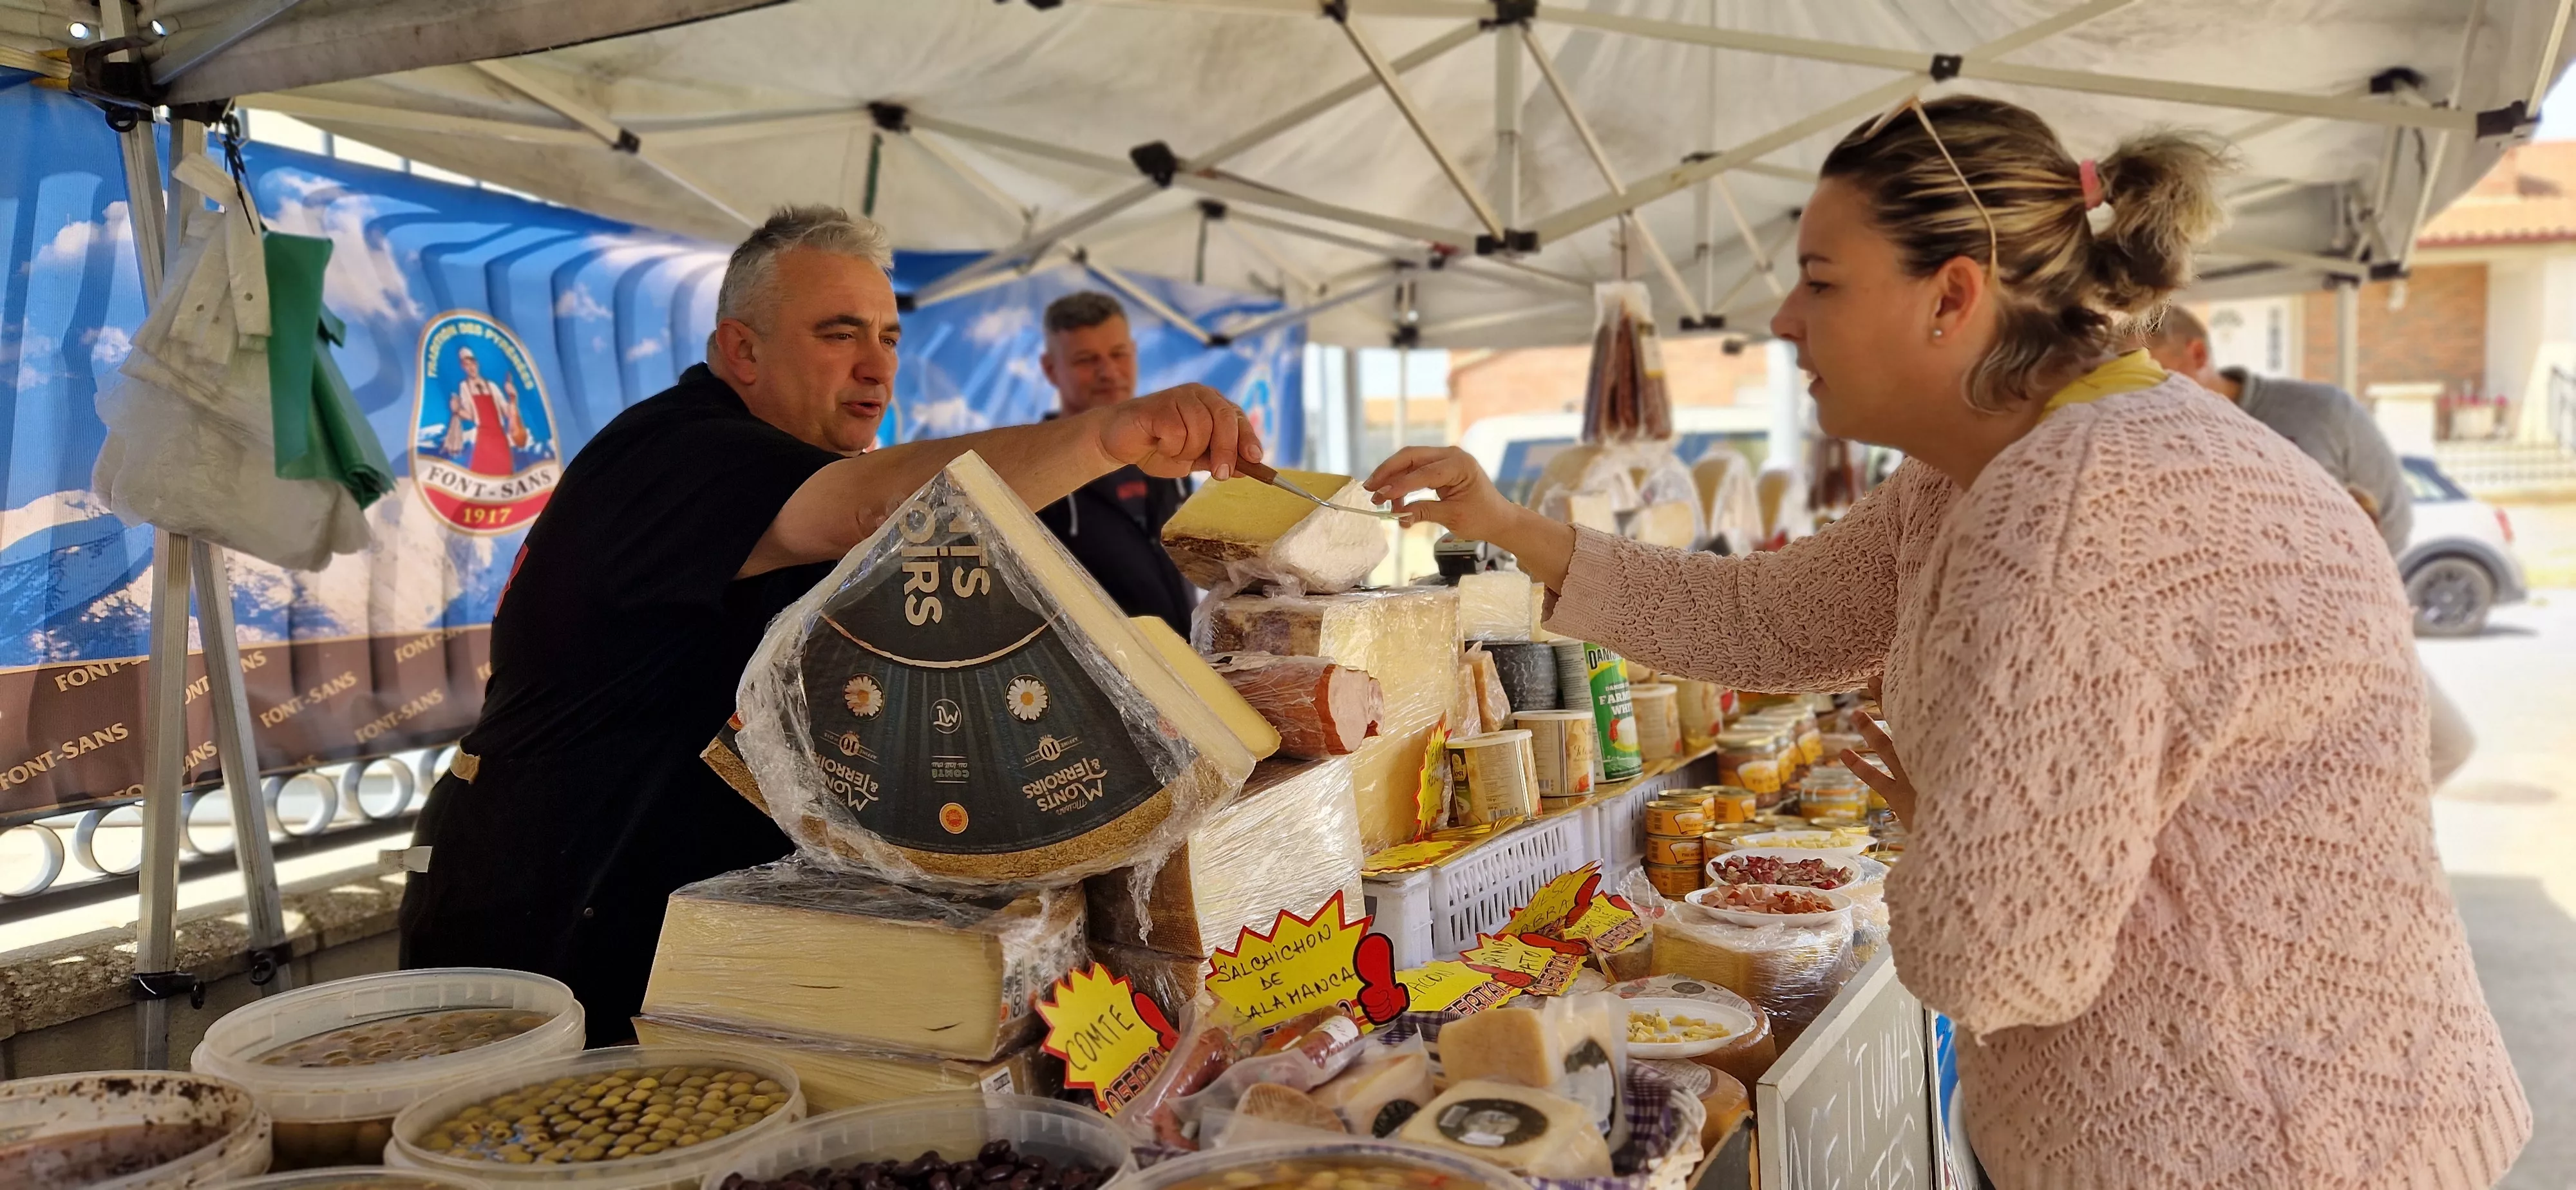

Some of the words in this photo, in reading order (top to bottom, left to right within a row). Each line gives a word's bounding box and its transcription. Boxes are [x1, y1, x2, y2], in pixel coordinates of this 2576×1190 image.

[462, 507, 513, 525] 1917
[54, 661, 142, 692] FONT-
[260, 671, 358, 728] FONT-SANS
[1598, 691, 1631, 705] FARM
[354, 688, 444, 743] FONT-SANS
[0, 722, 129, 791] FONT-SANS
[841, 737, 857, 753] 10
[1041, 741, 1059, 757] 10
[1090, 759, 1101, 770] &
[1037, 779, 1103, 812] MONTS
[1055, 798, 1088, 816] Maison
[1260, 972, 1284, 991] DE
[1442, 981, 1510, 1015] ERTA
[1065, 1004, 1135, 1072] COMTE
